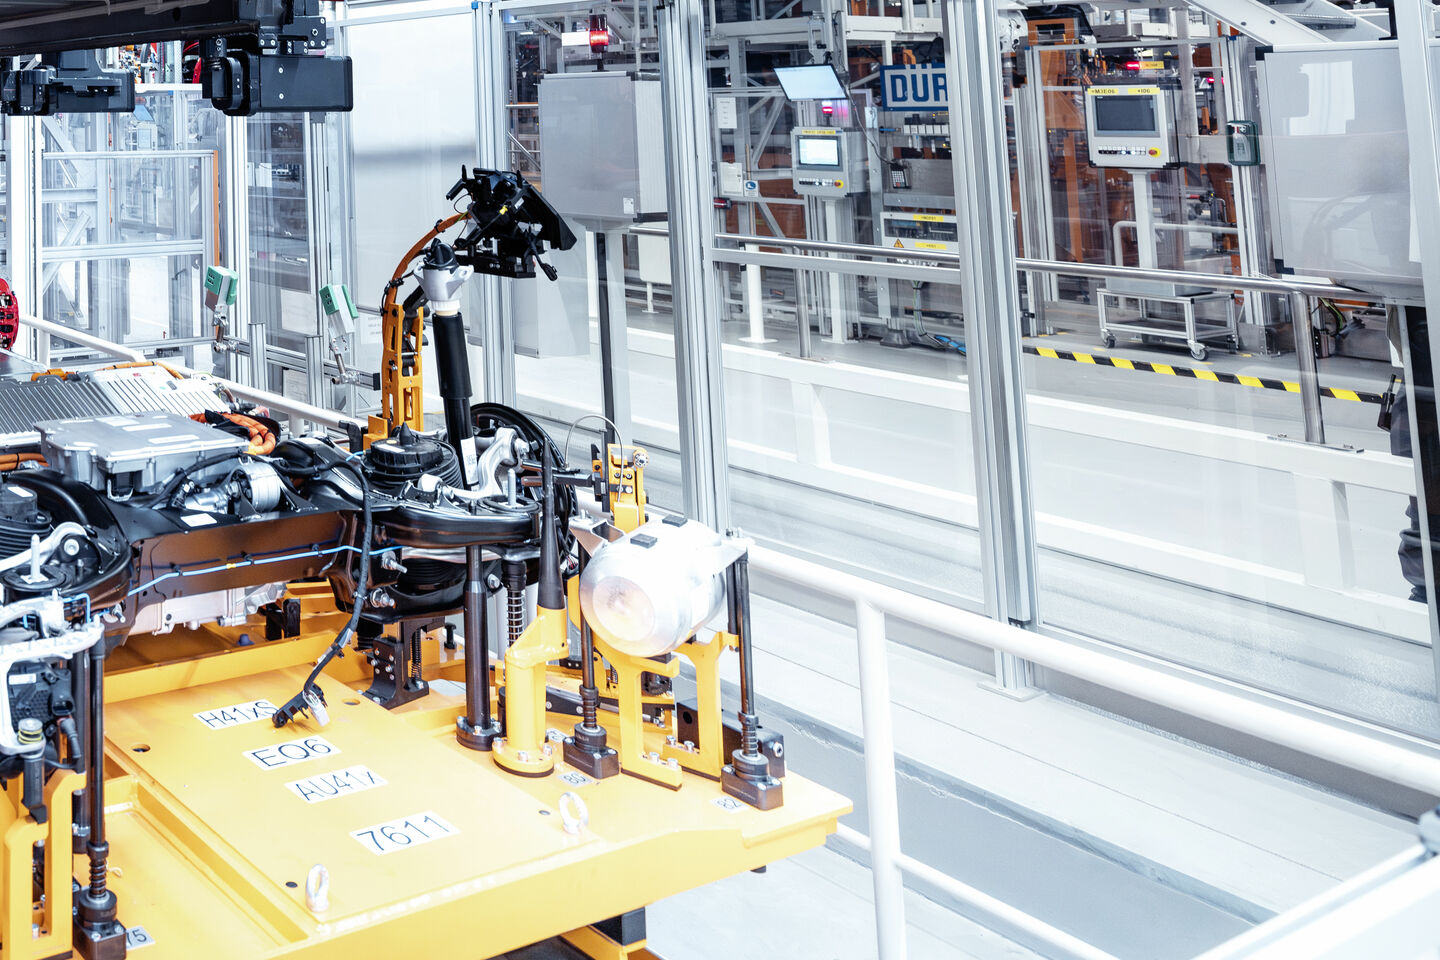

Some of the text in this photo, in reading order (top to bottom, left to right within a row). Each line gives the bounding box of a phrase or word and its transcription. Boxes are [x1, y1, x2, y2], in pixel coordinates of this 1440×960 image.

[250, 738, 333, 768] EQ6
[295, 770, 386, 802] AU41x
[355, 814, 451, 852] 7611
